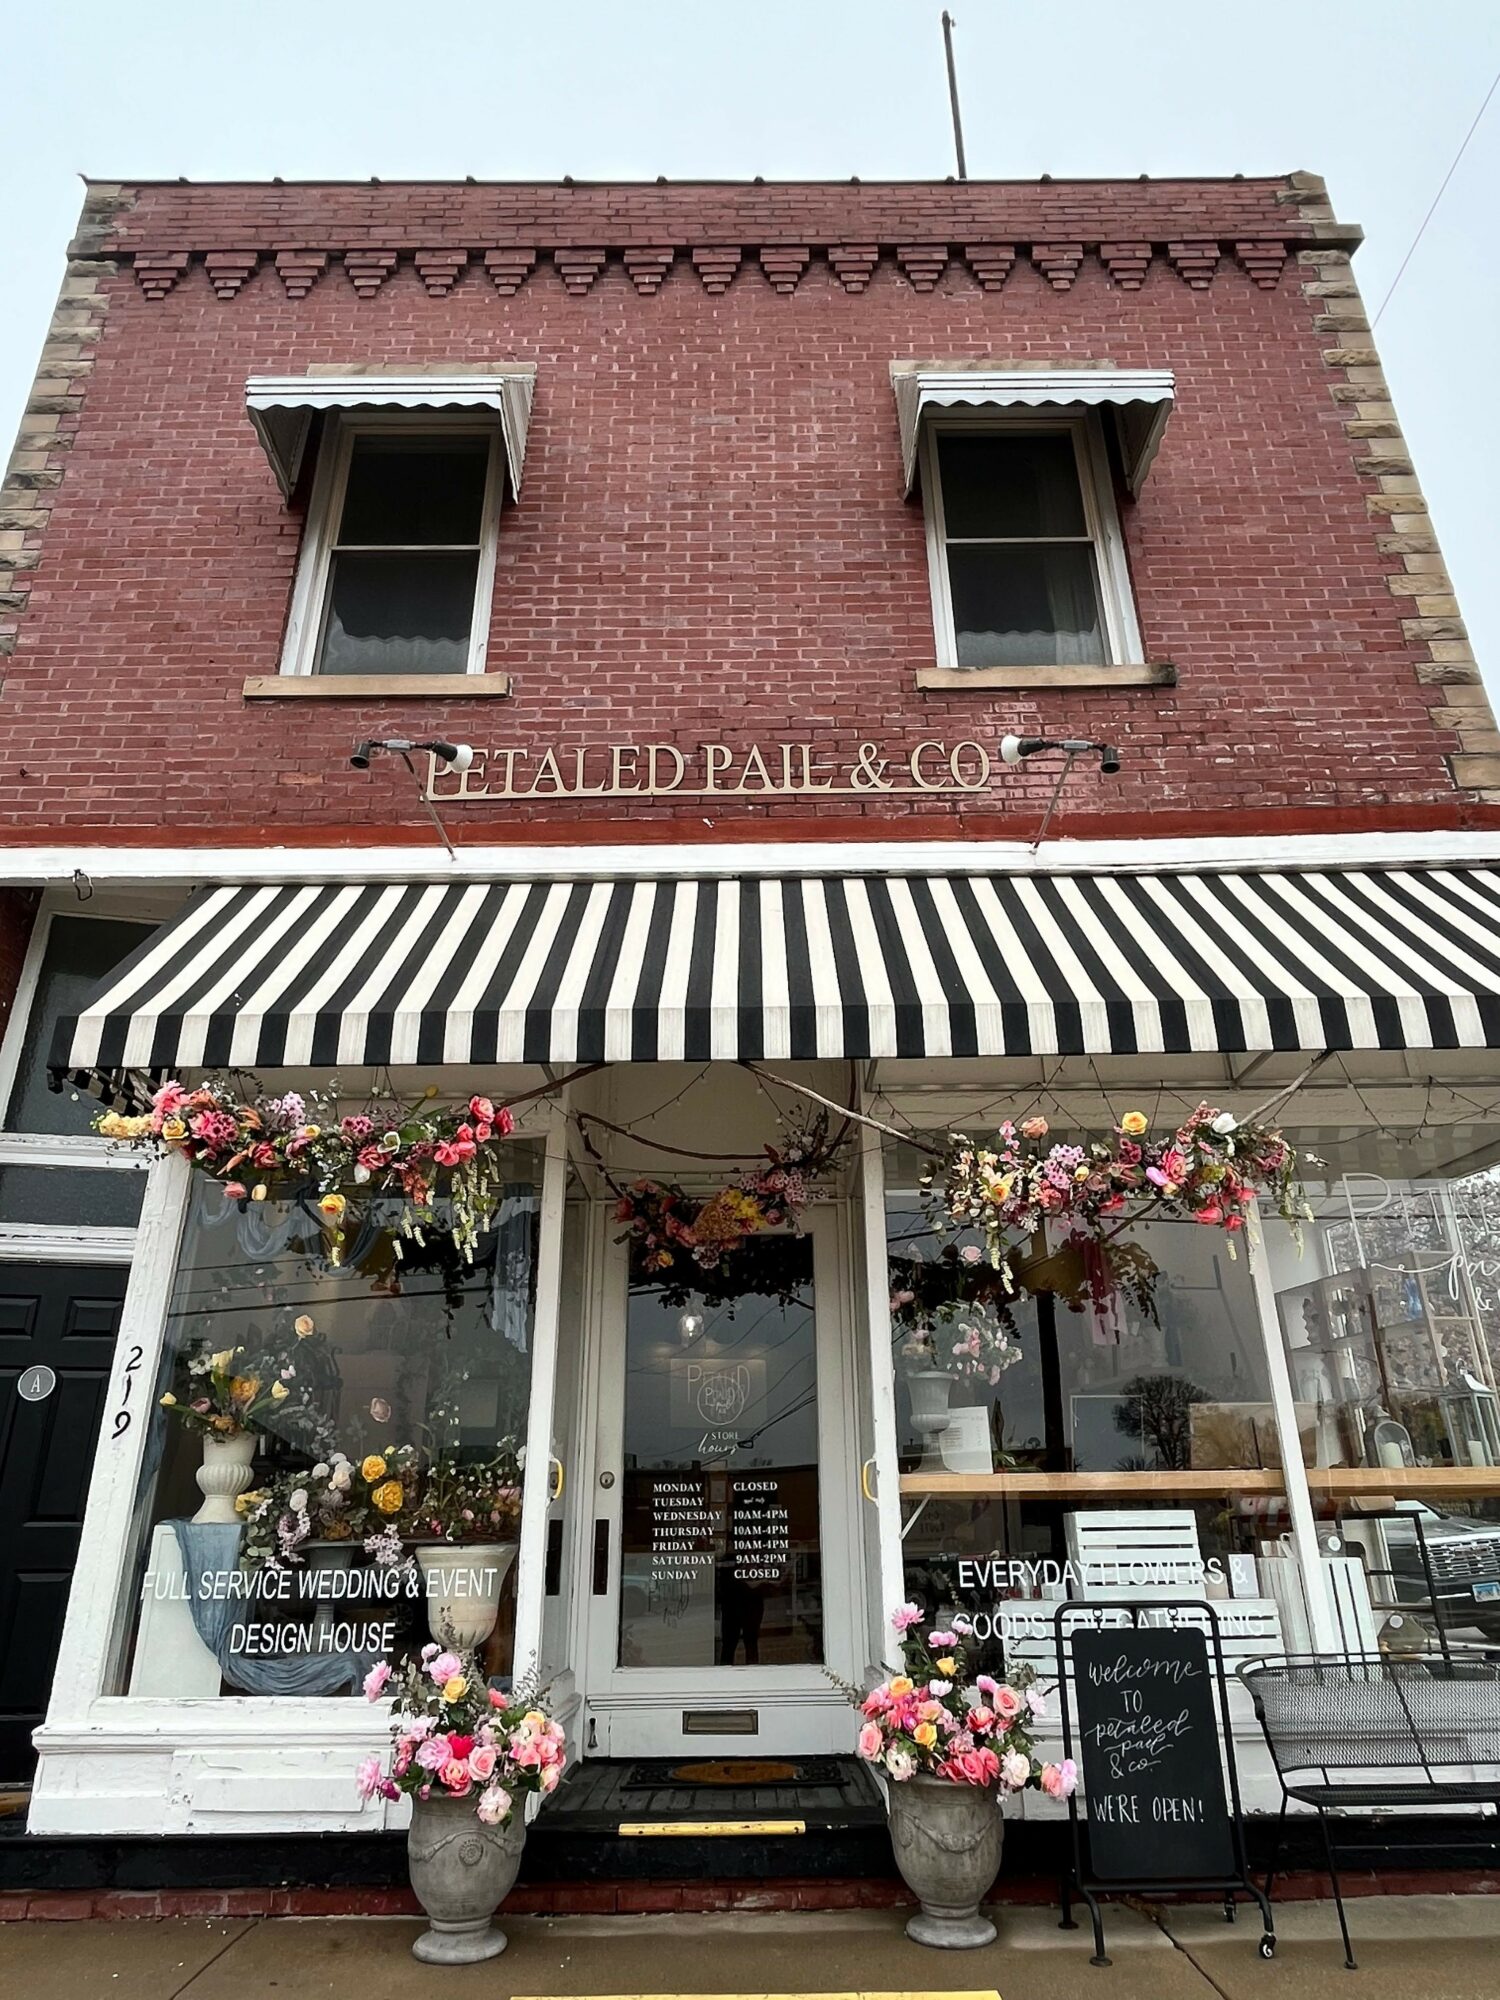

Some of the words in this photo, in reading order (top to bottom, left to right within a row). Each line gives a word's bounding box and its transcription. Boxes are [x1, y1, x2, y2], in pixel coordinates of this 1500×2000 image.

[425, 745, 685, 797] PETALED
[704, 744, 832, 791] PAIL
[850, 741, 895, 790] &
[910, 740, 991, 789] CO
[30, 1374, 41, 1393] A
[112, 1345, 143, 1439] 219
[653, 1483, 702, 1493] MONDAY
[733, 1481, 778, 1491] CLOSED
[653, 1497, 704, 1507] TUESDAY
[653, 1511, 722, 1521] WEDNESDAY
[733, 1510, 788, 1520] 10AM-4PM
[652, 1526, 715, 1536] THURSDAY
[733, 1525, 789, 1535] 10AM-4PM
[652, 1541, 695, 1551] FRIDAY
[733, 1540, 789, 1550] 10AM-4PM
[652, 1555, 715, 1565] SATURDAY
[736, 1554, 787, 1564] 9AM-2PM
[651, 1570, 698, 1580] SUNDAY
[734, 1569, 780, 1579] CLOSED
[958, 1560, 1090, 1588] EVERYDAY
[1100, 1557, 1224, 1586] FLOWERS
[1232, 1558, 1248, 1584] &
[140, 1571, 192, 1600] FULL
[199, 1570, 291, 1599] SERVICE
[299, 1569, 400, 1599] WEDDING
[405, 1569, 420, 1598] &
[426, 1568, 498, 1598] EVENT
[229, 1623, 312, 1653] DESIGN
[319, 1622, 396, 1652] HOUSE
[1120, 1689, 1143, 1713] TO
[1110, 1753, 1124, 1779] &
[1152, 1796, 1205, 1823] OPEN!
